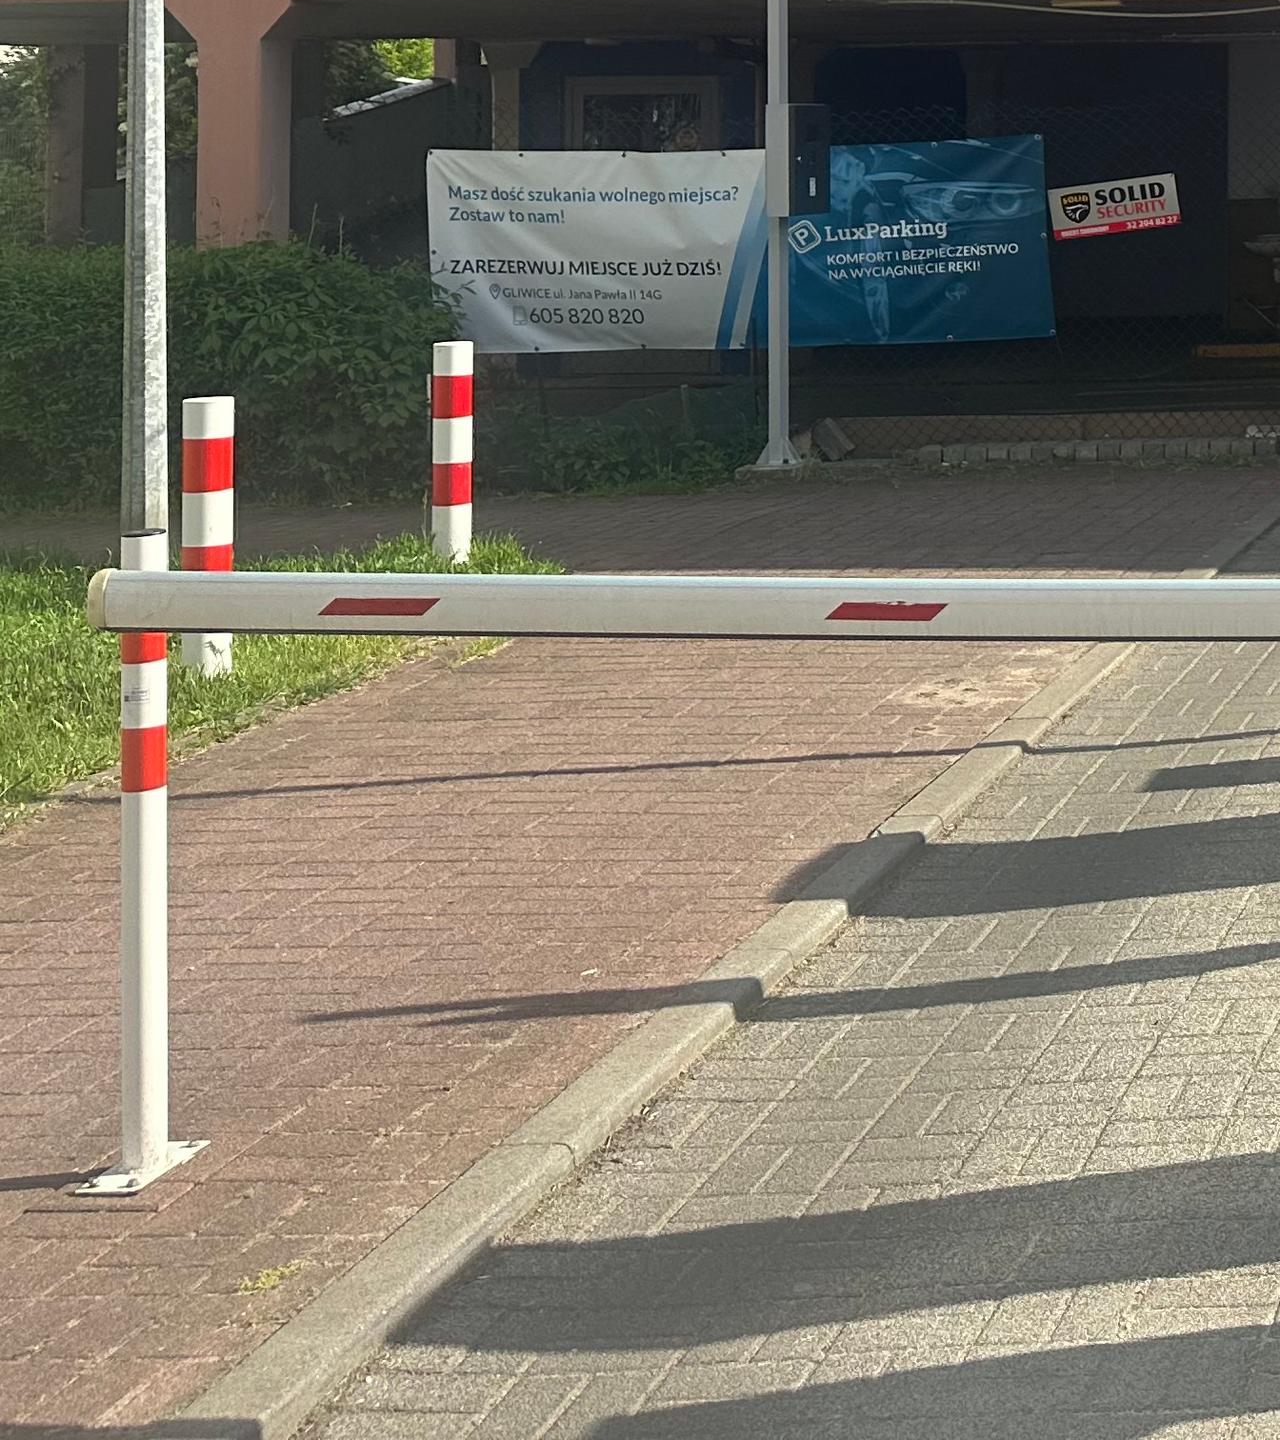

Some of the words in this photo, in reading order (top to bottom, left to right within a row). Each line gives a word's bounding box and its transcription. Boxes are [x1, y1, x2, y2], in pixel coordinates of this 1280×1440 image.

[448, 185, 487, 201] Masz
[491, 186, 525, 201] dość
[528, 187, 596, 202] szukania
[599, 187, 666, 206] wolnego
[668, 185, 739, 205] miejsca?
[1095, 182, 1165, 206] SOLID
[449, 207, 505, 222] Zostaw
[509, 209, 524, 222] to
[528, 209, 565, 223] nam!
[1096, 199, 1167, 219] SECURITY
[824, 218, 948, 242] LuxParking
[826, 250, 893, 266] KOMFORT
[902, 242, 1019, 262] BEZPIECZEŃSTWO
[450, 259, 564, 275] ZAREZERWUJ
[569, 261, 638, 276] MIEJSCE
[641, 258, 674, 276] JUŻ
[676, 258, 722, 276] DZIŚ!
[828, 268, 848, 281] NA
[849, 262, 946, 279] WYCIĄGNIĘCIE
[947, 260, 982, 275] RĘKI!
[502, 287, 550, 299] GLIWICE
[553, 289, 567, 299] ul.
[569, 289, 593, 300] Jana
[594, 289, 627, 301] Pawła
[629, 290, 636, 300] II
[639, 290, 662, 301] 14G
[529, 308, 564, 324] 605
[568, 308, 604, 324] 820
[608, 308, 645, 325] 820
